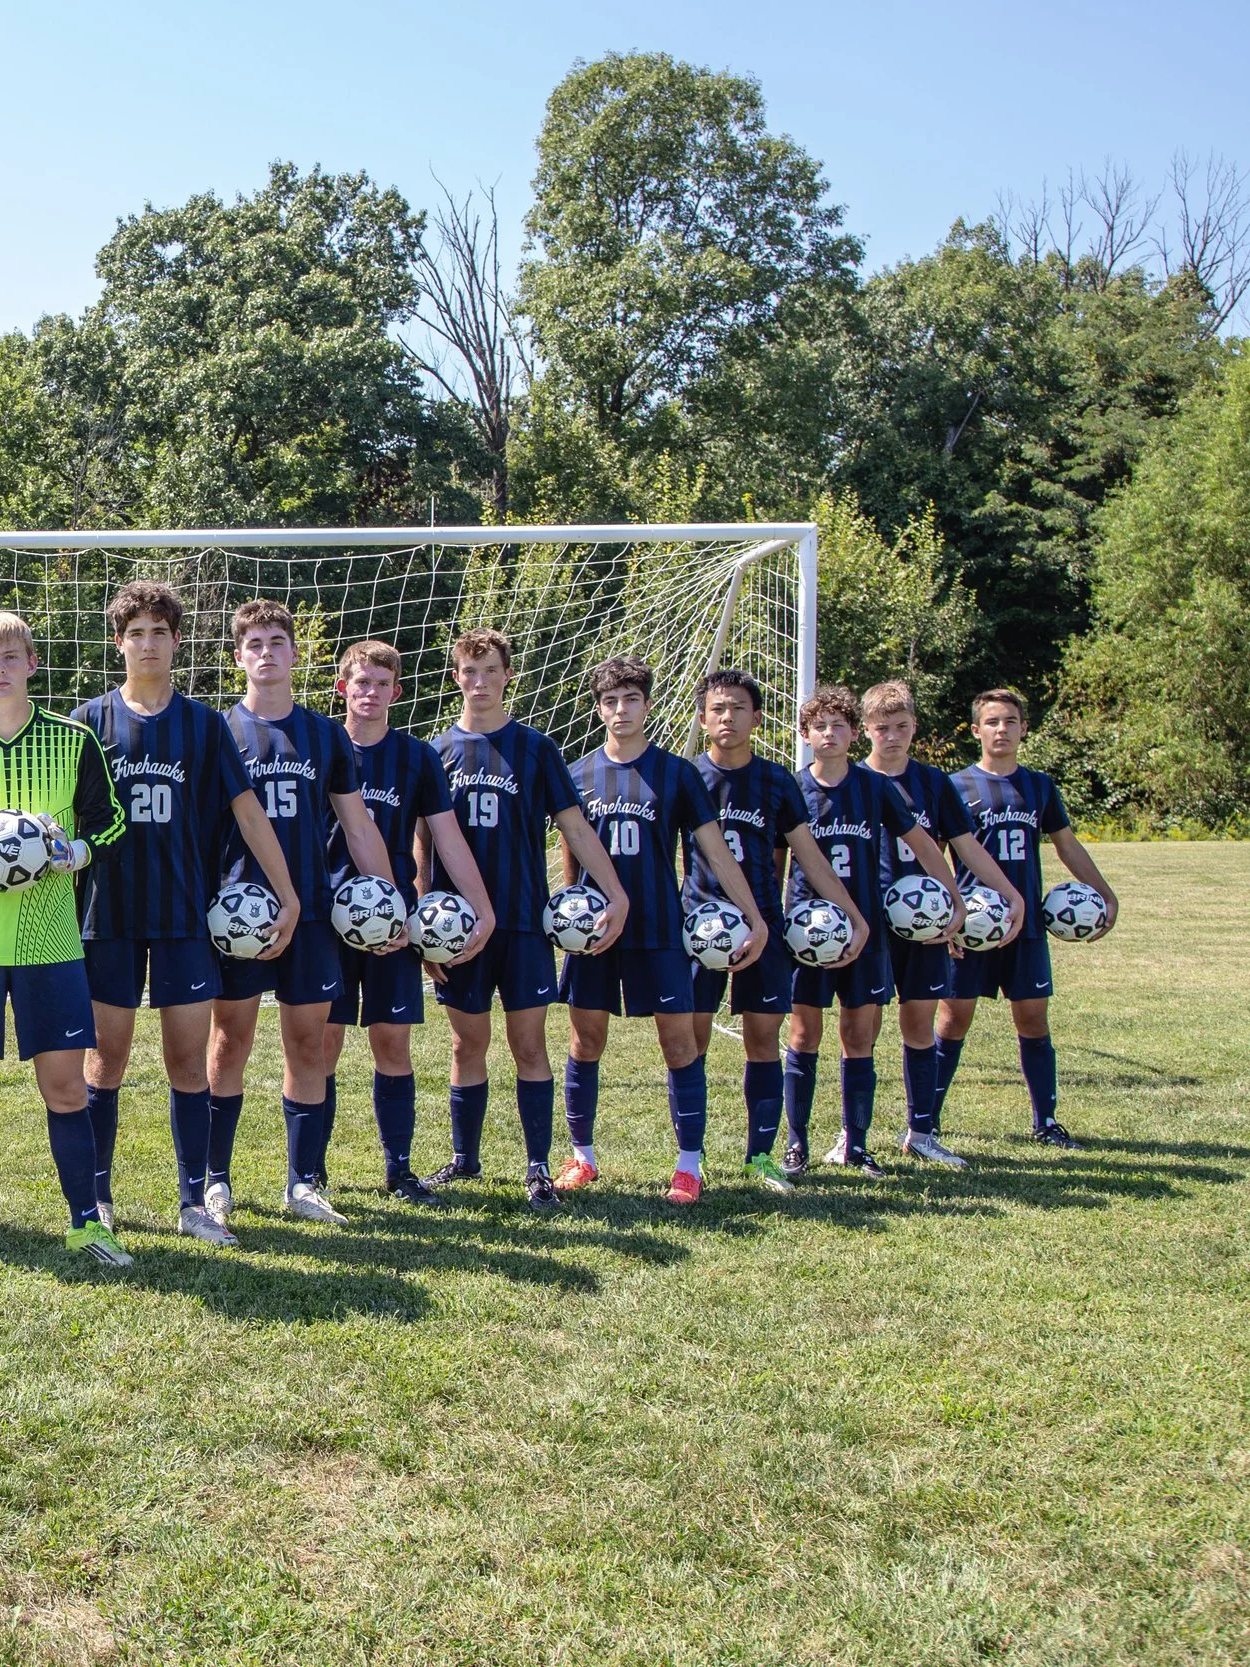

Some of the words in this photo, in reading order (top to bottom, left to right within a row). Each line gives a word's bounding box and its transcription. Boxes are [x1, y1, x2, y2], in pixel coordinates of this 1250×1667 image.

[111, 753, 186, 783] Firehawks
[245, 754, 317, 780] Firehawks
[449, 766, 519, 795] Firehawks
[131, 783, 172, 823] 20
[265, 780, 298, 818] 15
[361, 781, 401, 807] hawks
[468, 791, 499, 828] 19
[587, 795, 656, 821] Firehawks
[718, 801, 765, 828] ehawks
[979, 805, 1038, 830] Firehawks
[609, 820, 640, 855] 10
[998, 829, 1026, 861] 12
[831, 844, 851, 877] 2
[350, 903, 395, 921] BRINE
[965, 900, 1003, 919] BRINE
[228, 922, 267, 937] BRIN
[553, 918, 595, 929] BRINE
[808, 930, 847, 942] BRINE
[421, 933, 467, 949] BRINE
[691, 937, 732, 949] BRINE
